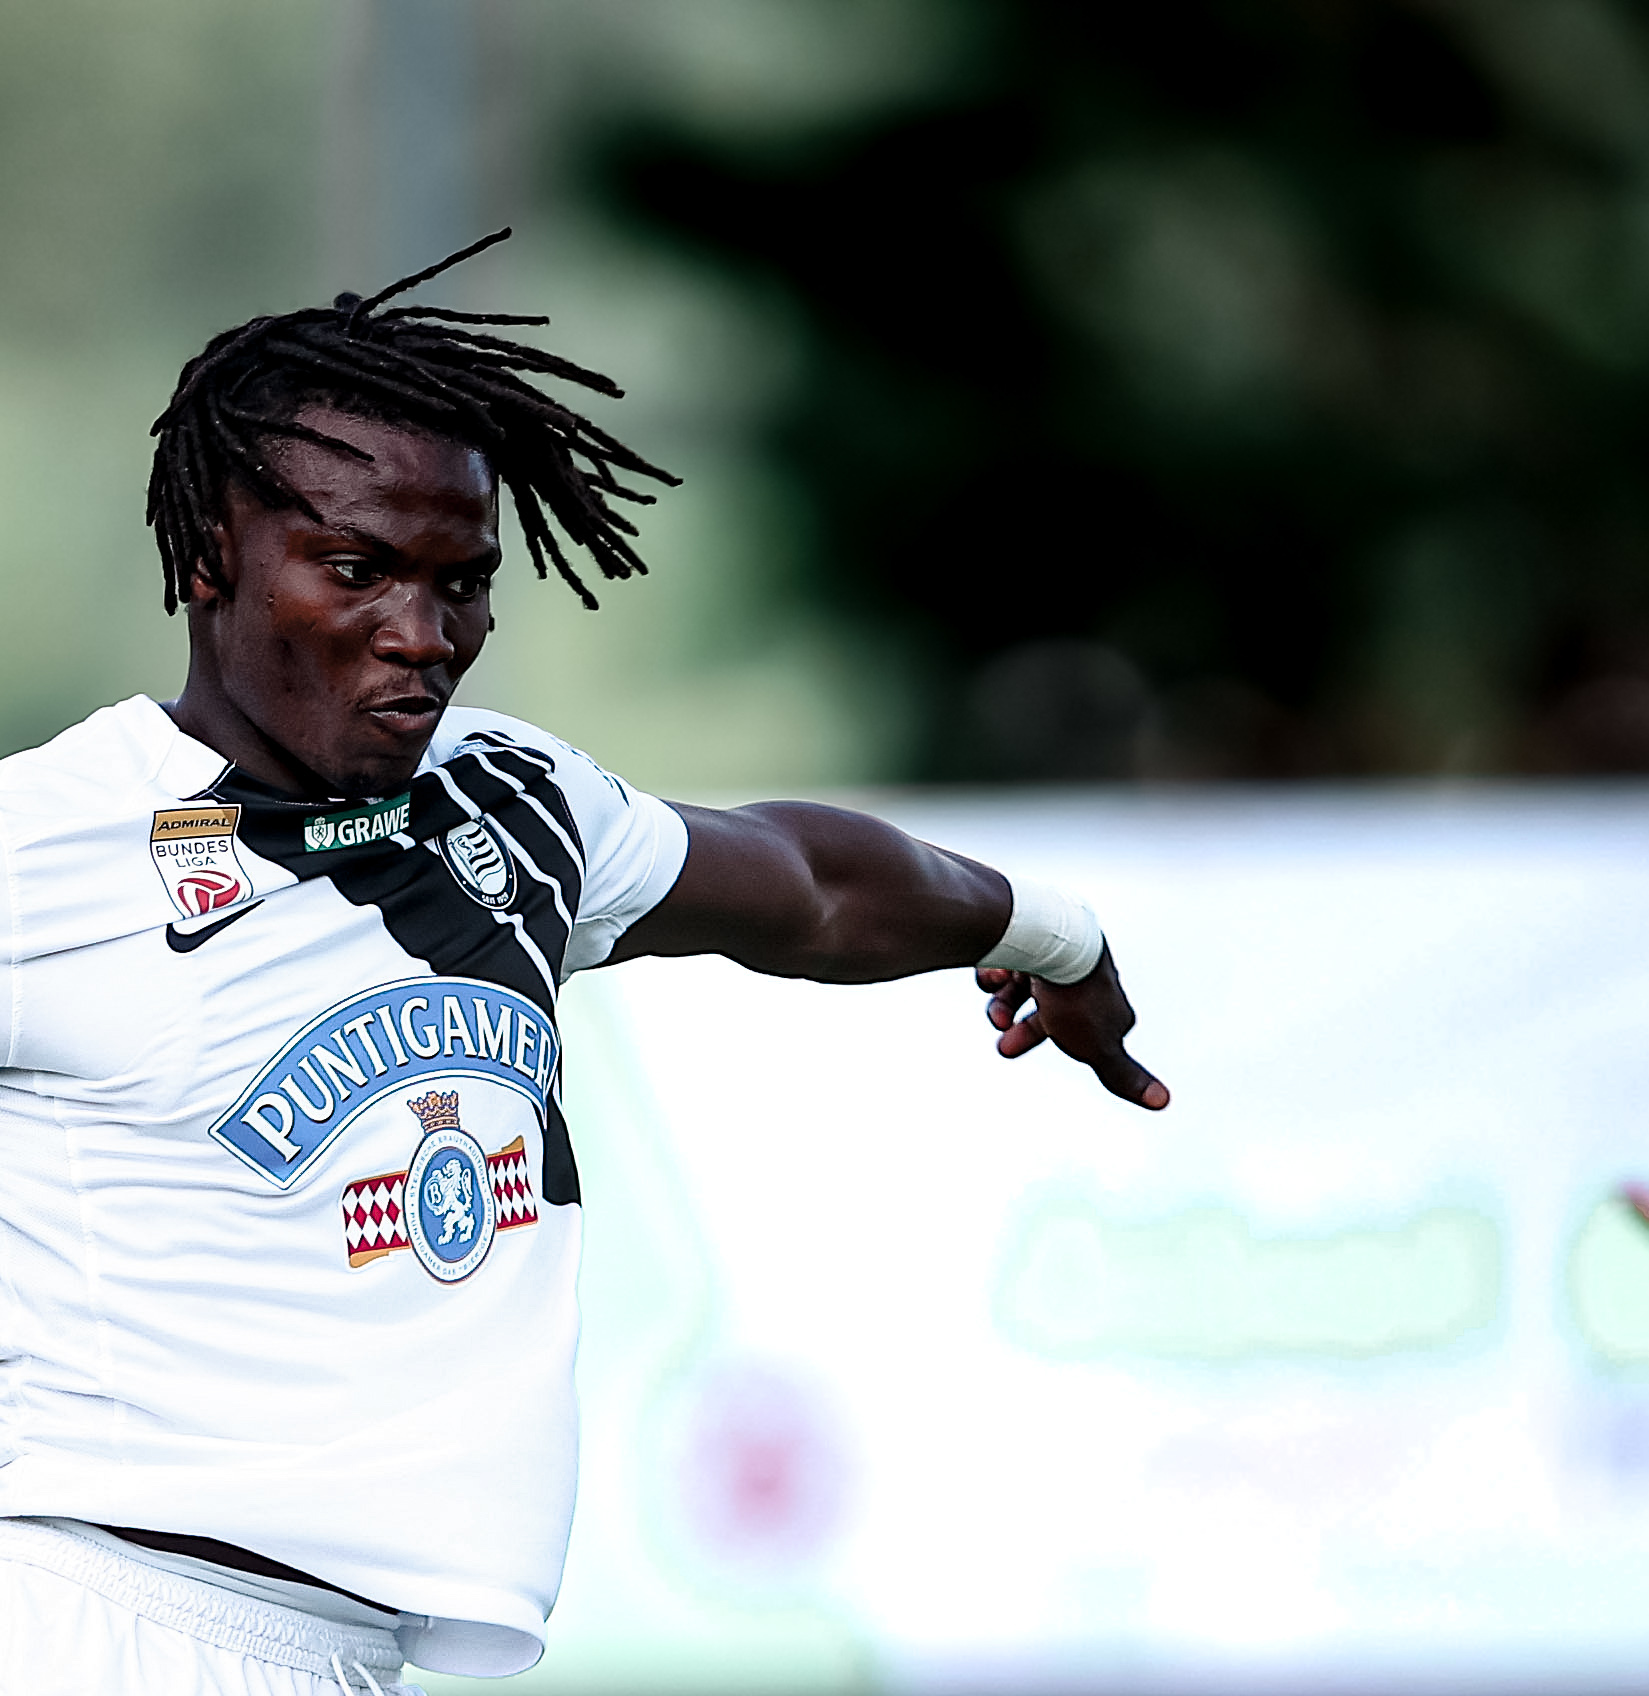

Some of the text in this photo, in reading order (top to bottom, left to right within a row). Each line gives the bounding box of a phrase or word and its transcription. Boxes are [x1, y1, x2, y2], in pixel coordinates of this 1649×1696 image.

[156, 817, 232, 832] ADMIRAL
[337, 802, 410, 846] GRAWE
[155, 840, 229, 858] BUNDES
[175, 856, 217, 868] LIGA
[239, 994, 554, 1164] PUNTIGAMER
